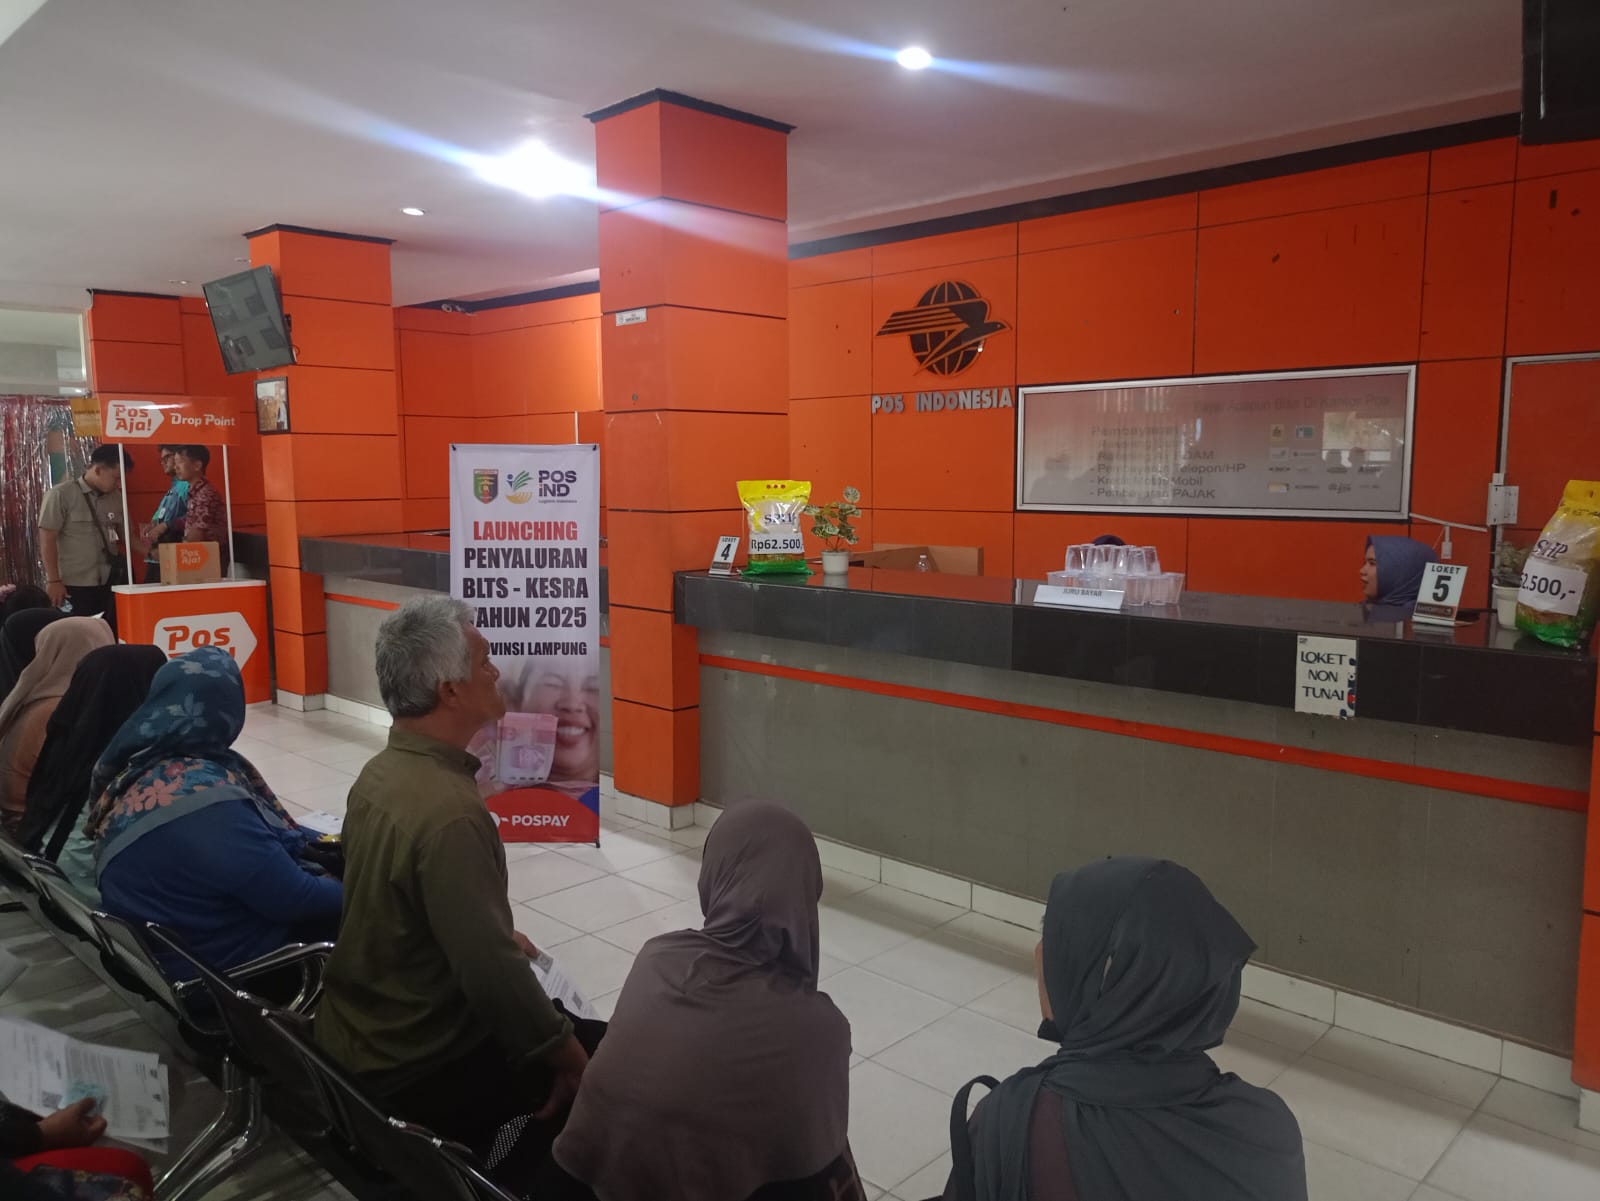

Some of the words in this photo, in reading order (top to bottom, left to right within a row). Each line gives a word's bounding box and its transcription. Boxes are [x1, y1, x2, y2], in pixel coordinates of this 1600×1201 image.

[871, 394, 904, 414] POS
[916, 388, 1013, 412] INDONESIA
[113, 404, 148, 418] Pos
[115, 417, 152, 434] Aja!
[170, 412, 201, 427] Drop
[204, 413, 236, 426] Point
[538, 470, 577, 483] POS
[1174, 488, 1216, 499] PAJAK
[473, 520, 578, 541] LAUNCHING
[180, 548, 199, 557] Pos
[464, 547, 588, 569] PENYALURAN
[721, 543, 732, 561] 4
[1431, 565, 1461, 574] LOKET
[463, 577, 509, 599] BLTS
[526, 577, 589, 599] KESRA
[1432, 575, 1451, 602] 5
[475, 606, 530, 628] AHUN
[535, 606, 587, 628] 2025
[163, 625, 230, 650] Pos
[490, 642, 525, 656] VINSI
[528, 641, 588, 656] LAMPUNG
[1301, 651, 1348, 665] LOKET
[1308, 669, 1338, 682] NON
[1302, 685, 1345, 701] TUNAI
[511, 815, 570, 827] POSPAY
